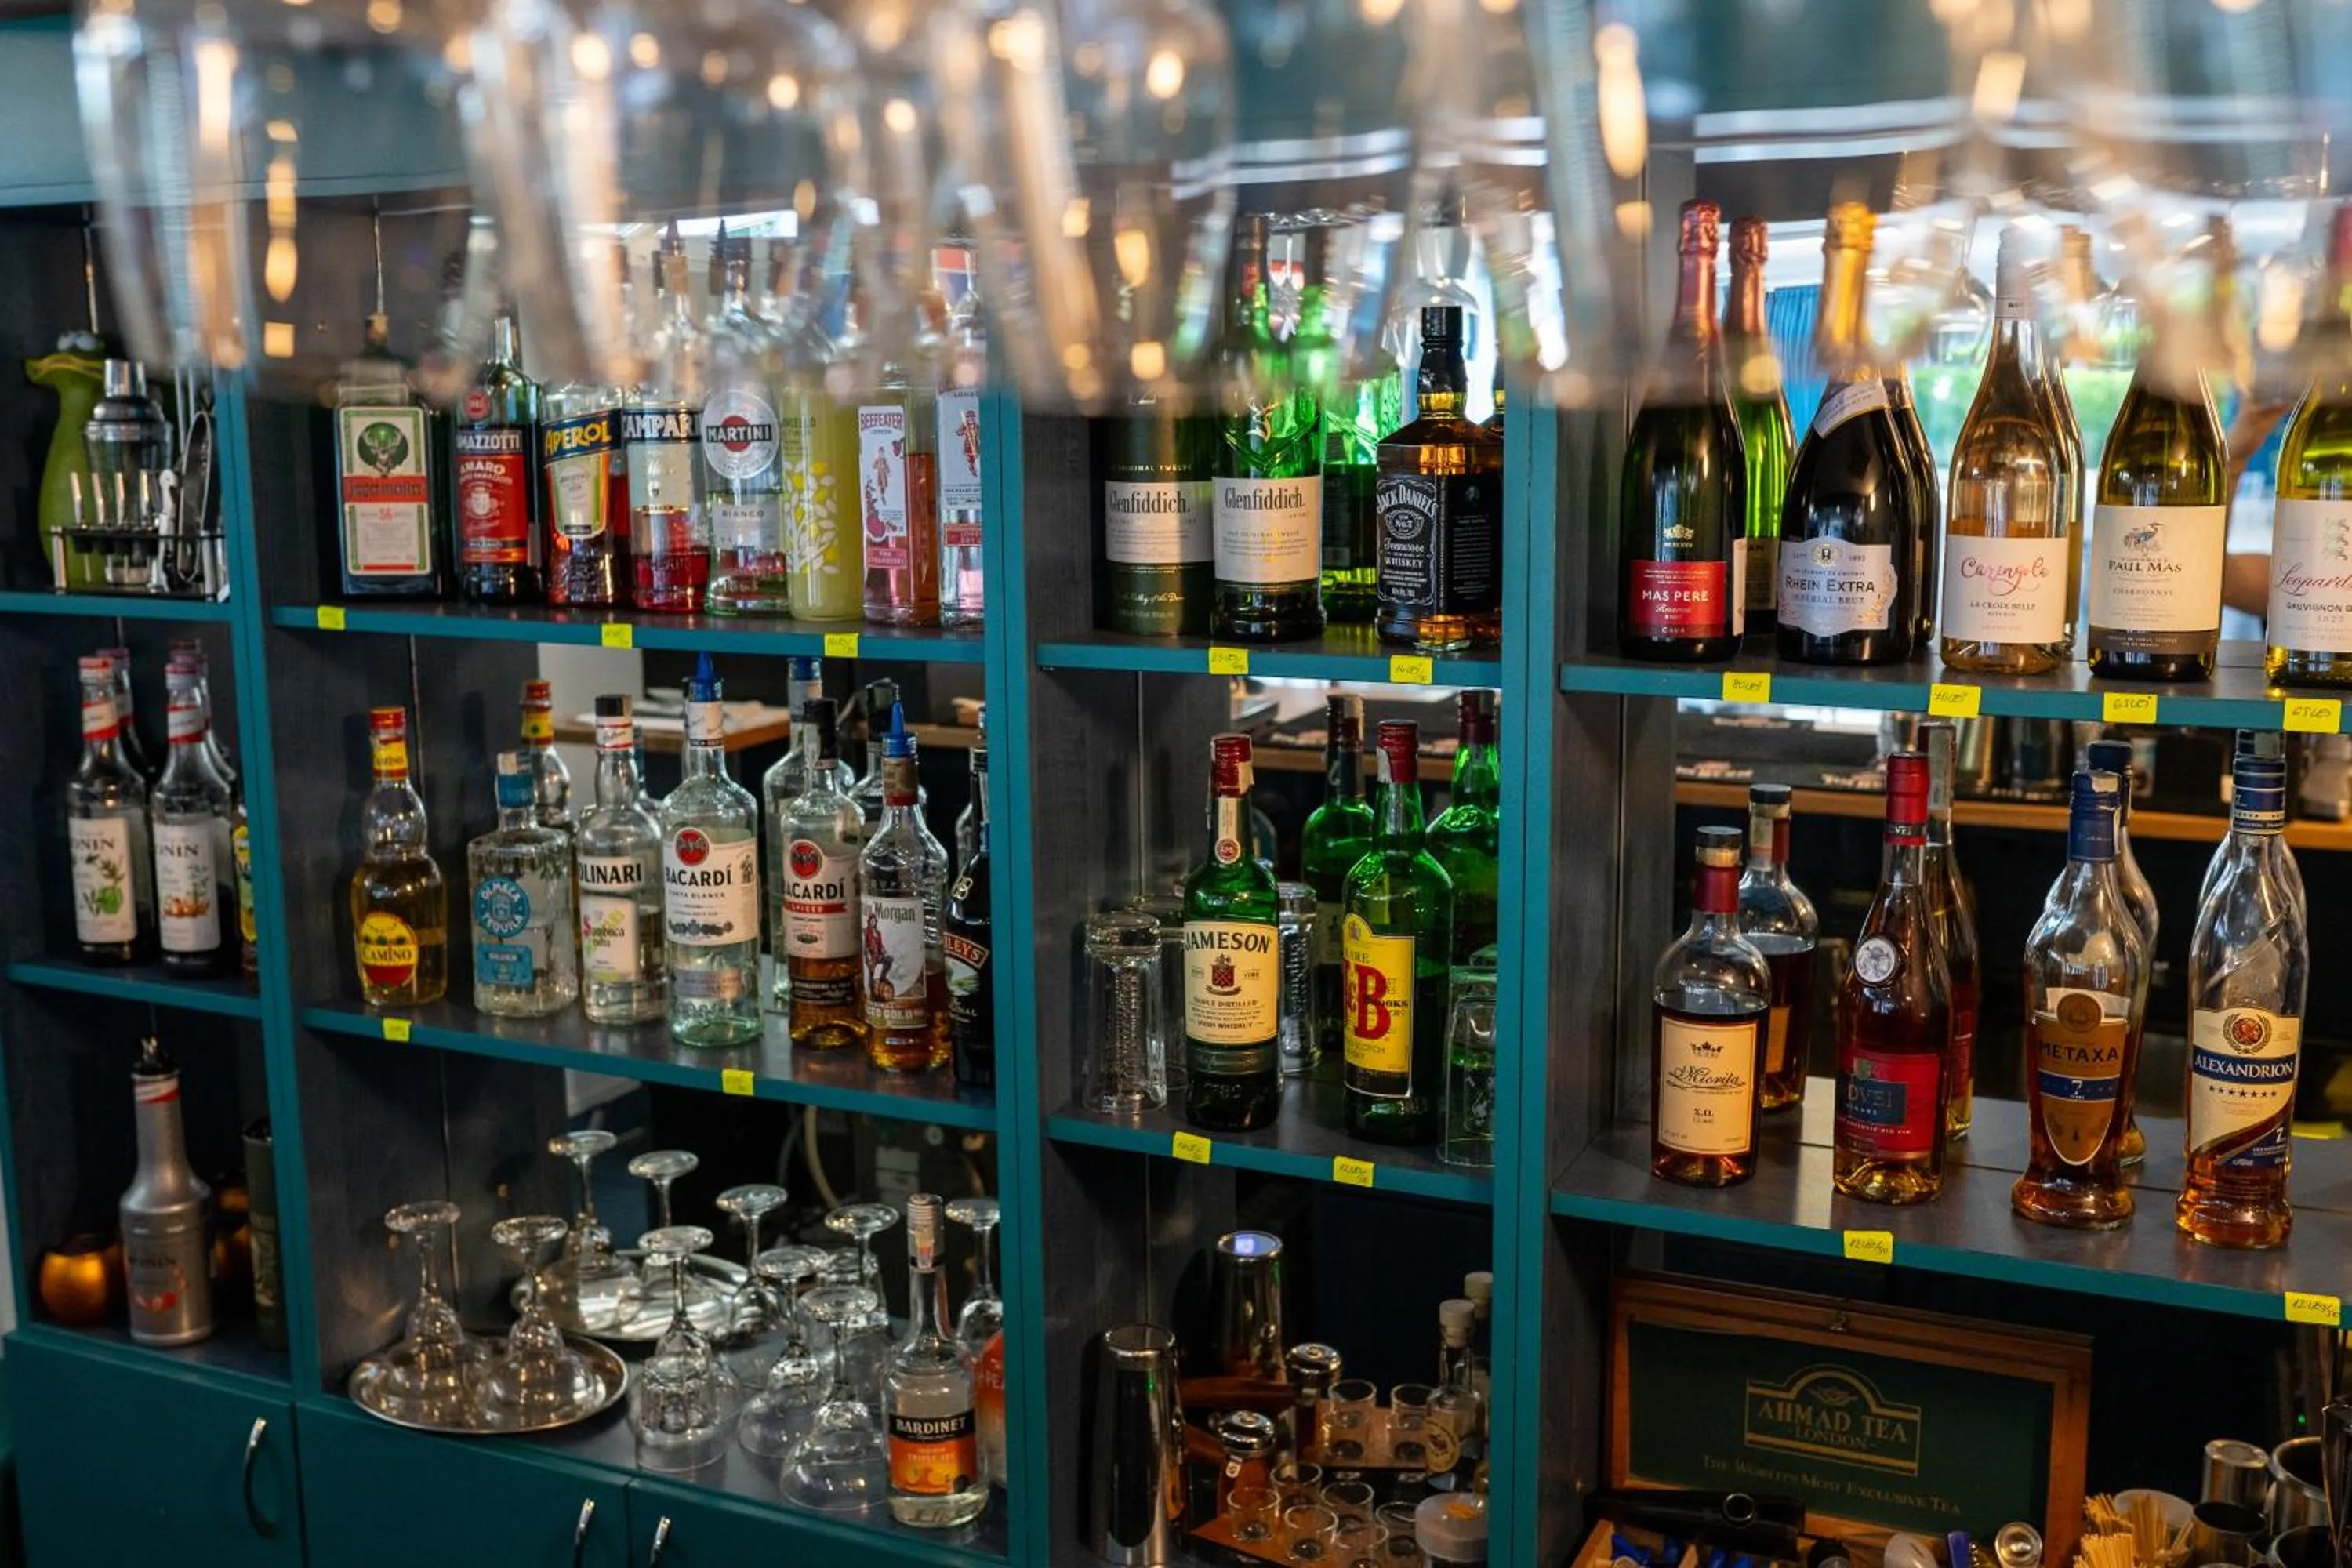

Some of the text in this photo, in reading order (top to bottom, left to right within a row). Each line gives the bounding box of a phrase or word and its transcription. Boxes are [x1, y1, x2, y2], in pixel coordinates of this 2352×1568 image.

[860, 412, 902, 430] BEEFEATER
[546, 420, 612, 456] APEROL
[707, 426, 771, 442] MARTINI
[460, 461, 506, 475] AMARO
[1377, 488, 1398, 514] JACK
[2108, 560, 2143, 572] PAUL
[1785, 575, 1875, 592] RHEIN EXTRA
[1642, 590, 1709, 601] MAS PERE
[2286, 601, 2342, 612] SAUVIGNON
[875, 902, 916, 924] Morgan
[1185, 931, 1271, 954] JAMESON
[2039, 1044, 2119, 1062] METAXA
[2195, 1055, 2294, 1079] ALEXANDRION
[2071, 1080, 2083, 1094] 7
[895, 1417, 966, 1435] BARDINET
[1757, 1399, 1908, 1443] AHMAD TEA
[1795, 1427, 1868, 1450] LONDON
